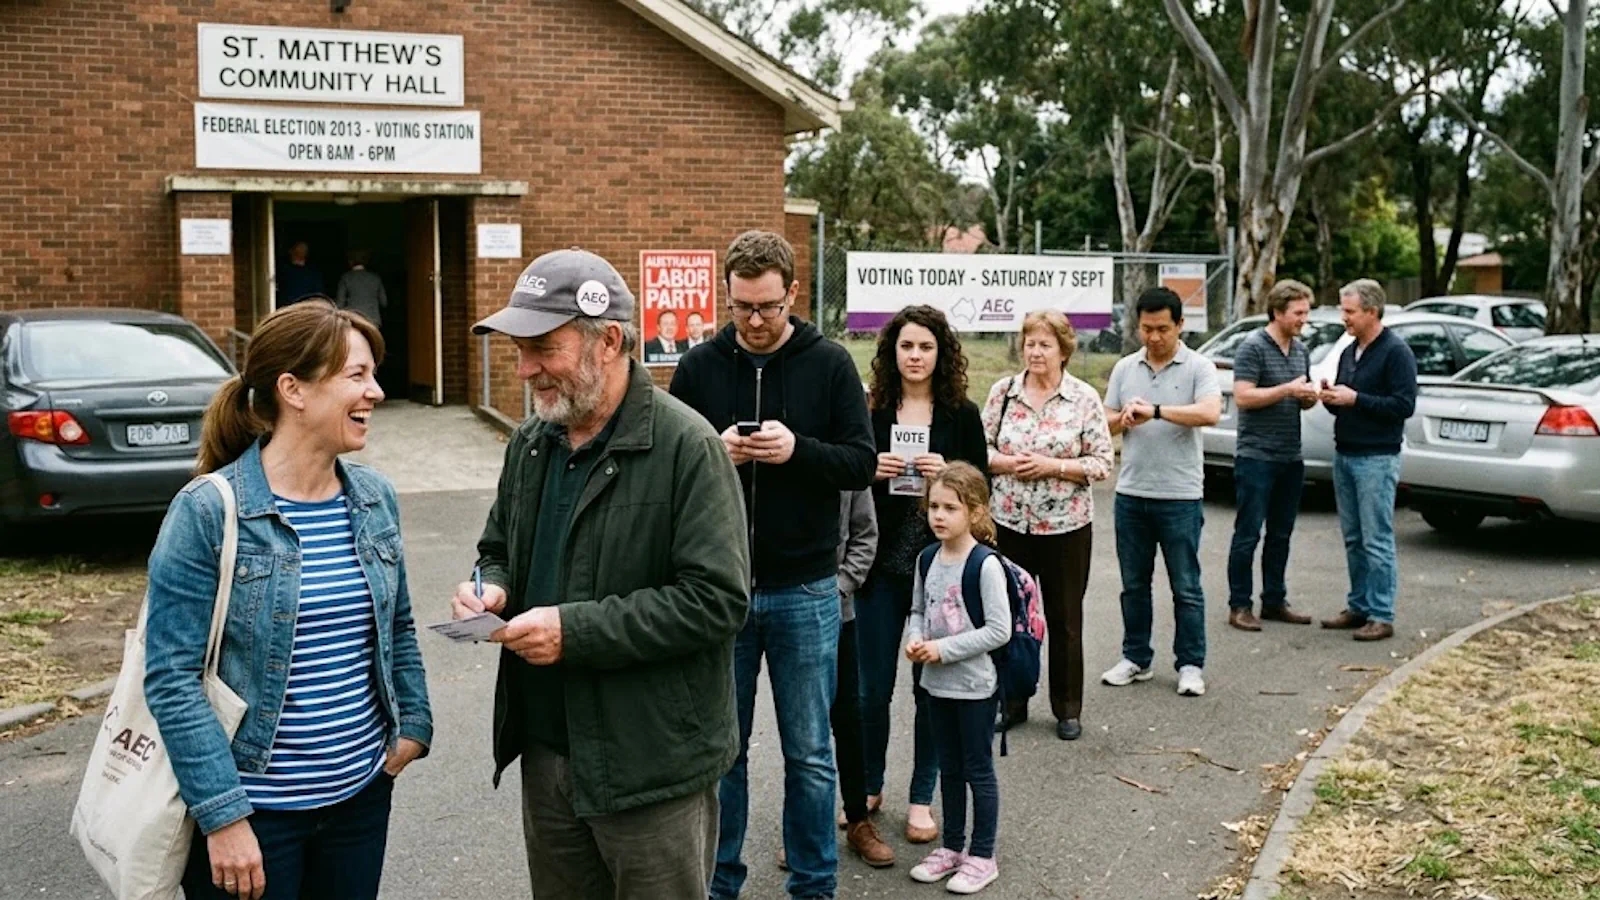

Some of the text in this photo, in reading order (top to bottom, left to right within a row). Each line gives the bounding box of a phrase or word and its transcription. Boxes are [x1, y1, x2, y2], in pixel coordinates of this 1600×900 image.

[222, 36, 442, 66] ST. MATTHEW'S
[218, 67, 446, 95] COMMUNITY HALL
[202, 116, 260, 134] FEDERAL
[264, 119, 326, 136] ELECTION
[330, 121, 362, 137] 2013
[375, 121, 420, 139] VOTING
[424, 124, 474, 140] STATION
[288, 143, 323, 160] OPEN
[326, 144, 354, 161] 8AM
[368, 146, 396, 161] 6PM
[645, 256, 711, 268] AUSTRALIAN
[519, 274, 547, 289] AEC
[645, 268, 711, 288] LABOR
[857, 267, 913, 286] VOTING
[918, 268, 966, 286] TODAY
[981, 270, 1054, 287] SATURDAY
[1059, 271, 1067, 286] 7
[1071, 271, 1105, 288] SEPT
[580, 291, 606, 305] AEC
[645, 288, 711, 310] PARTY
[981, 299, 1015, 313] AEC
[894, 431, 926, 444] VOTE
[112, 727, 156, 762] AEC
